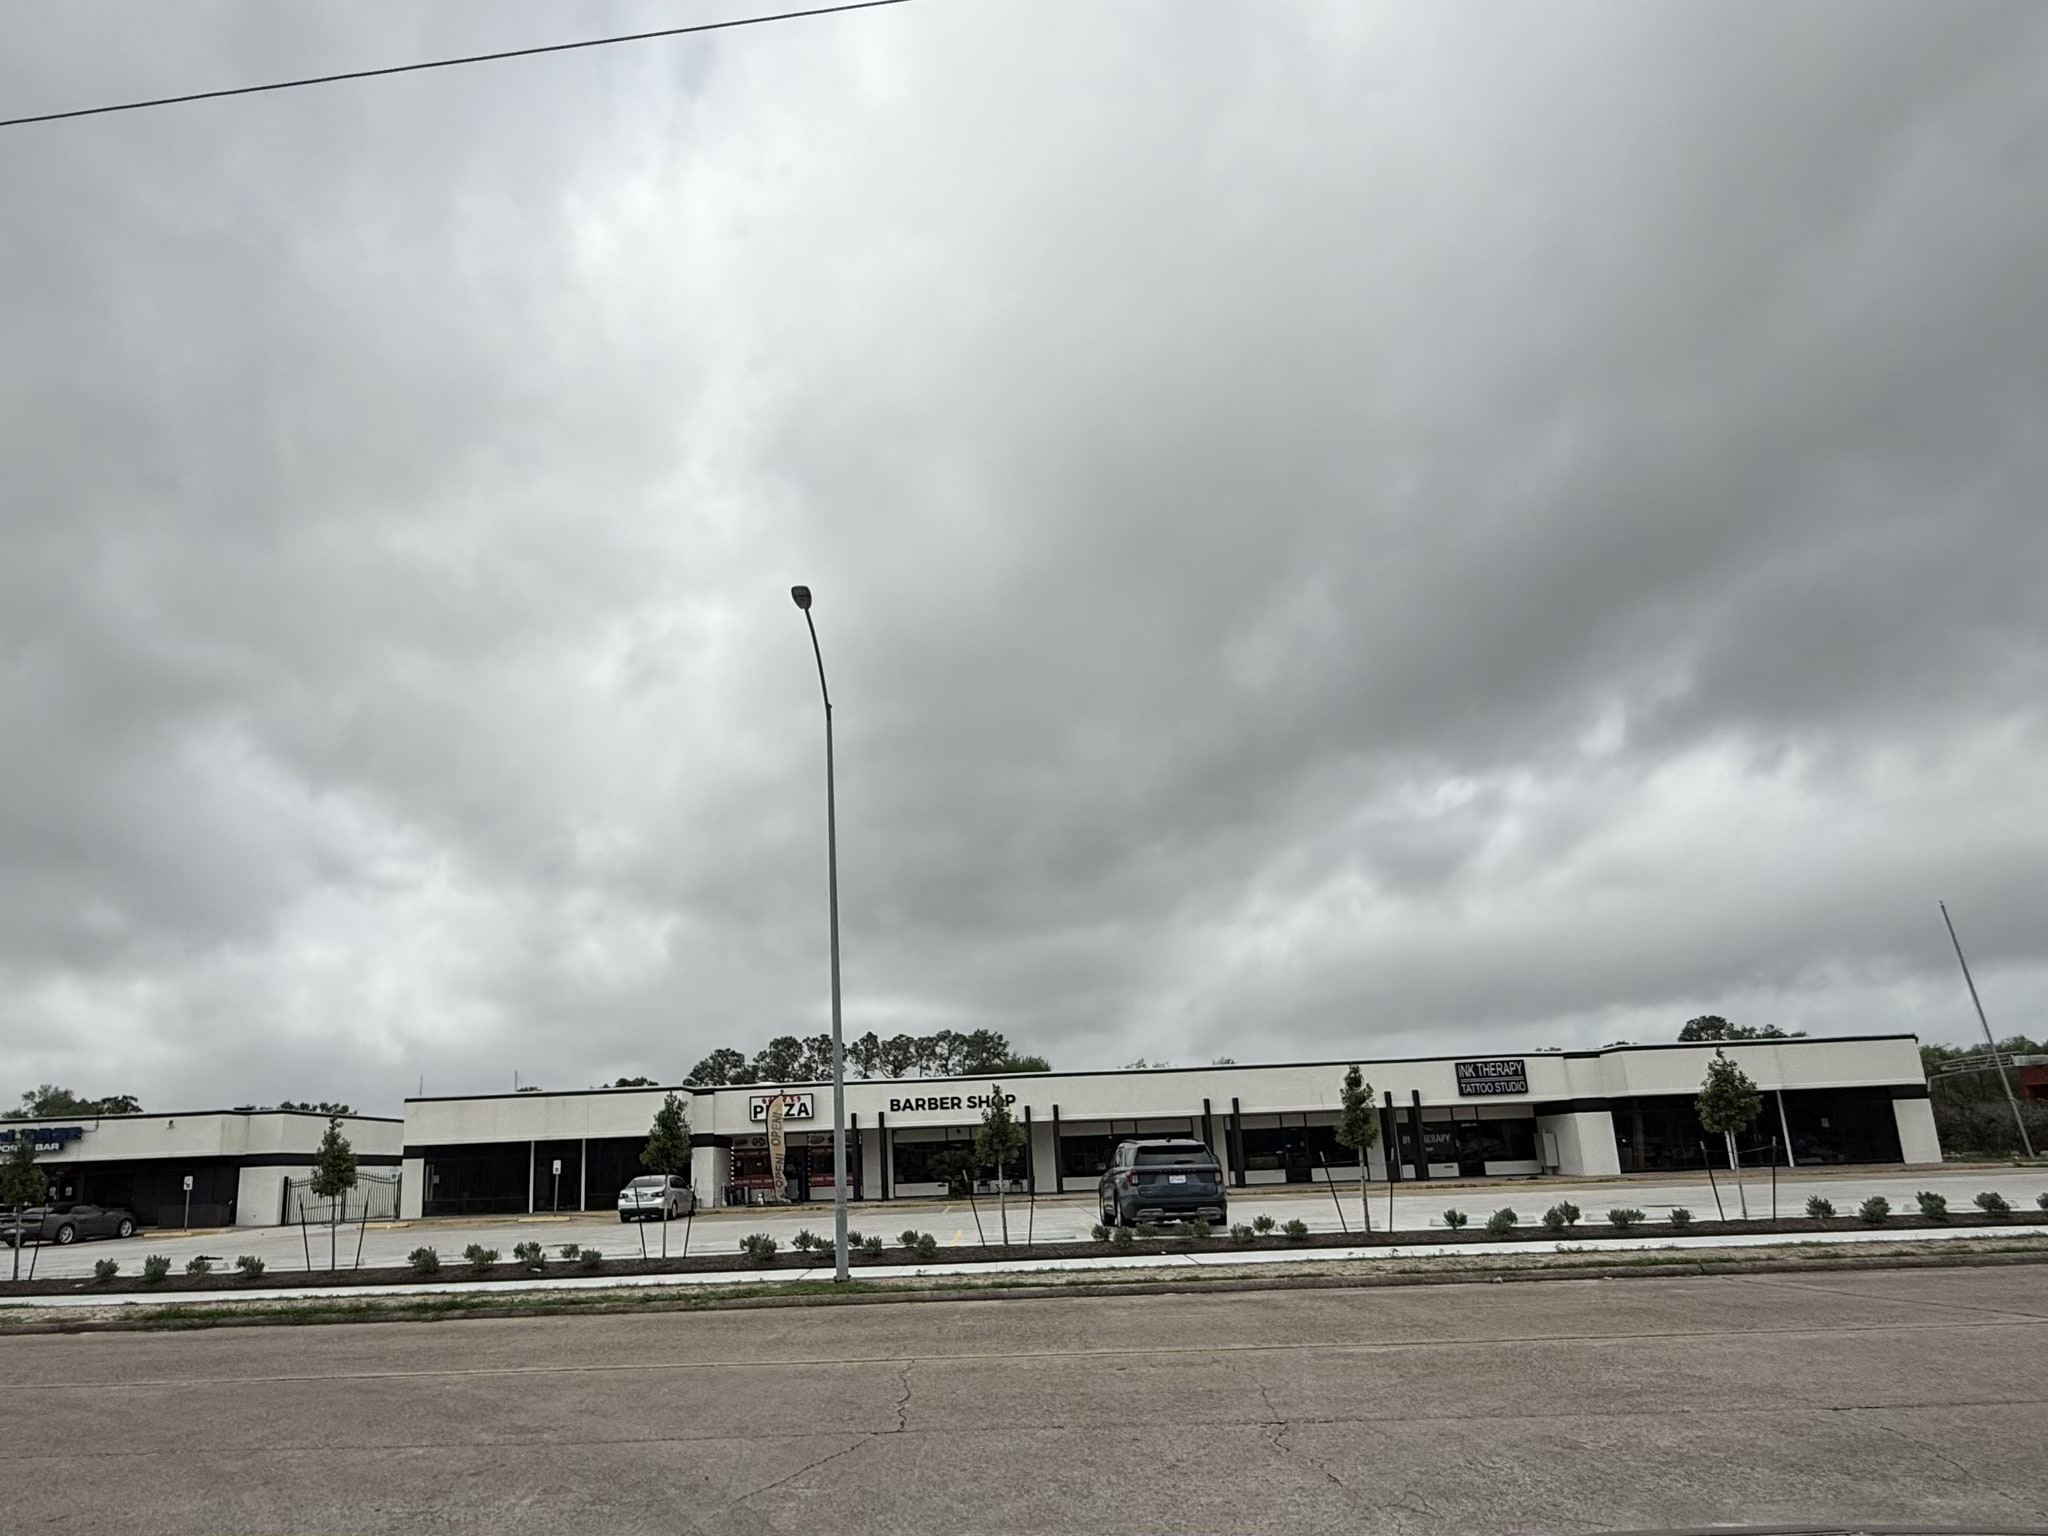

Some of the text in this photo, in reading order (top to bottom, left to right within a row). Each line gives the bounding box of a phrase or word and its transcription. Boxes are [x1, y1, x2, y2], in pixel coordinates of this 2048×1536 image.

[1458, 1062, 1522, 1077] INK THERAPY
[1461, 1081, 1526, 1093] TATTOO STUDIO
[889, 1096, 962, 1112] BARBER
[35, 1143, 59, 1151] BAR
